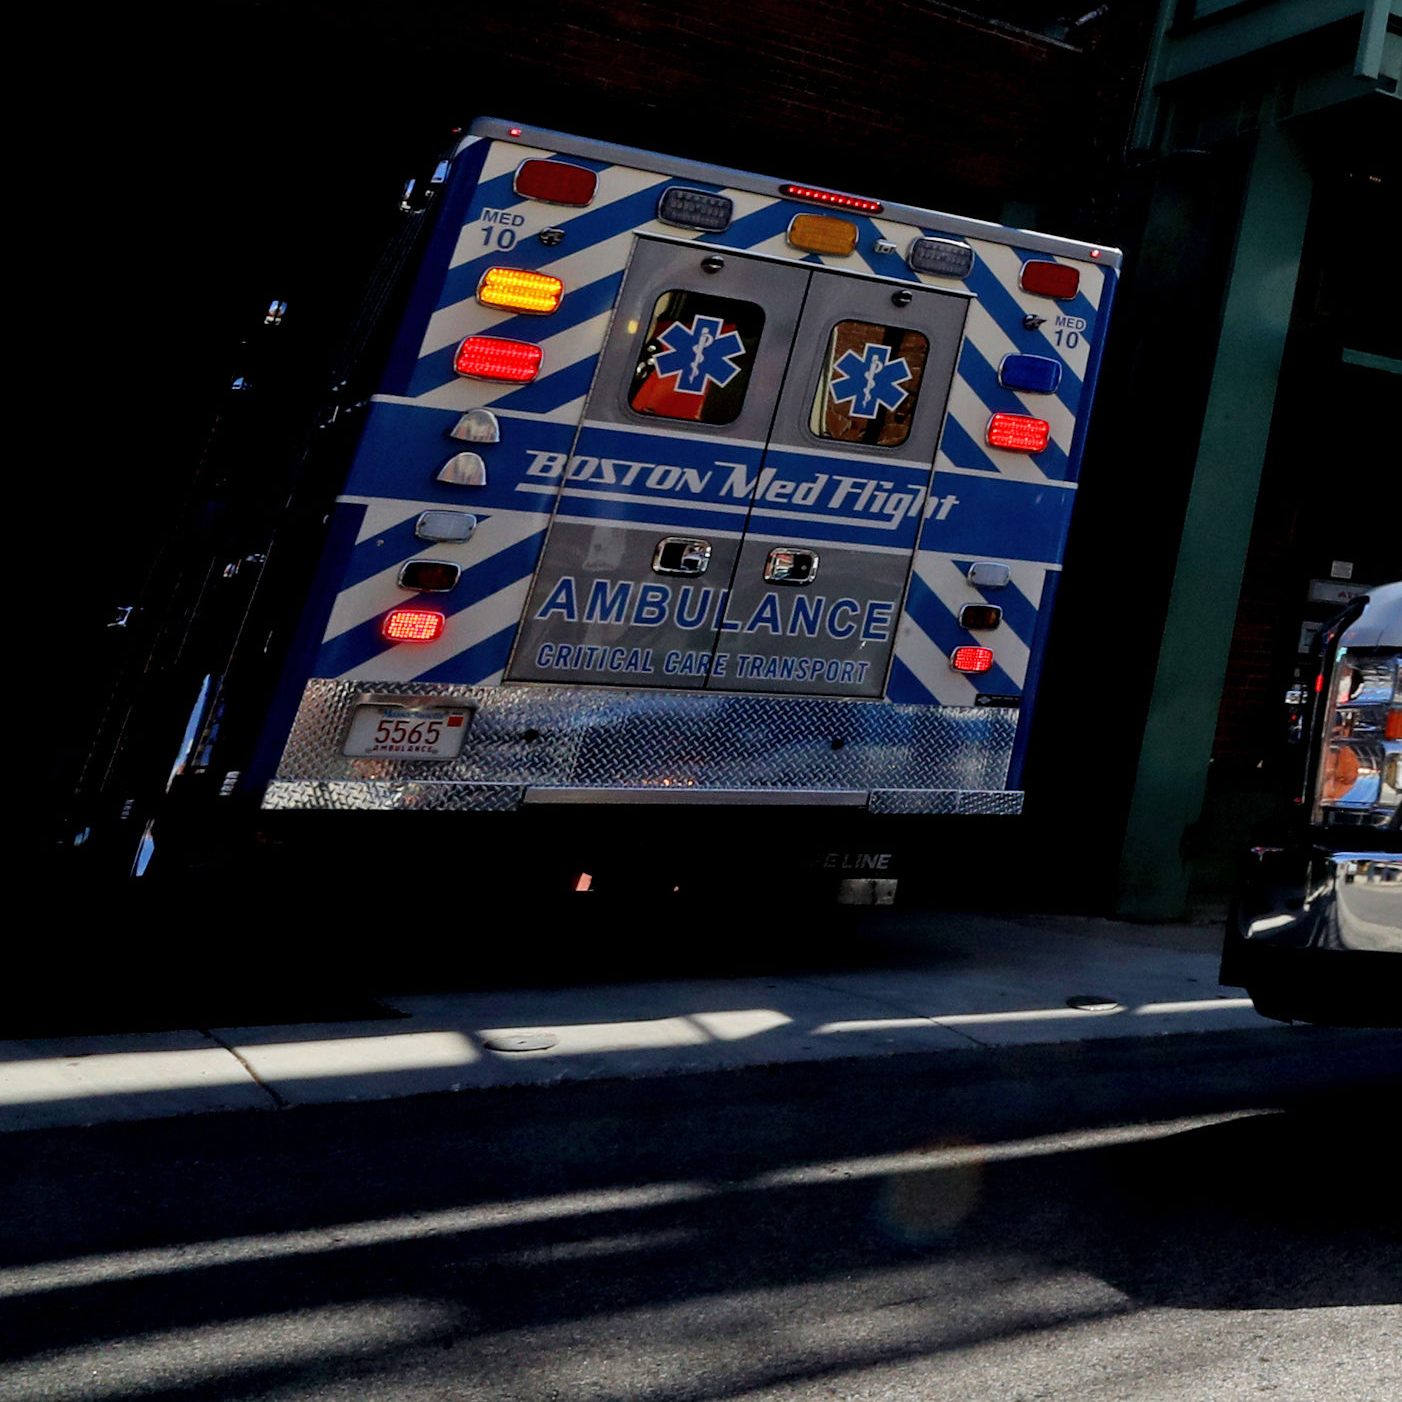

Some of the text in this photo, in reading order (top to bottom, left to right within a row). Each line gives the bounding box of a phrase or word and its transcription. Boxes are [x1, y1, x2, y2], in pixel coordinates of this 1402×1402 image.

[482, 209, 525, 227] MED
[481, 226, 516, 249] 10
[1055, 316, 1085, 330] MED
[1055, 329, 1079, 349] 10
[525, 449, 713, 496] BOSTON
[534, 575, 899, 643] AMBULANCE
[536, 642, 872, 685] CRITICAL CARE TRANSPORT
[375, 719, 443, 744] 5565
[373, 744, 433, 753] AMBULANCE
